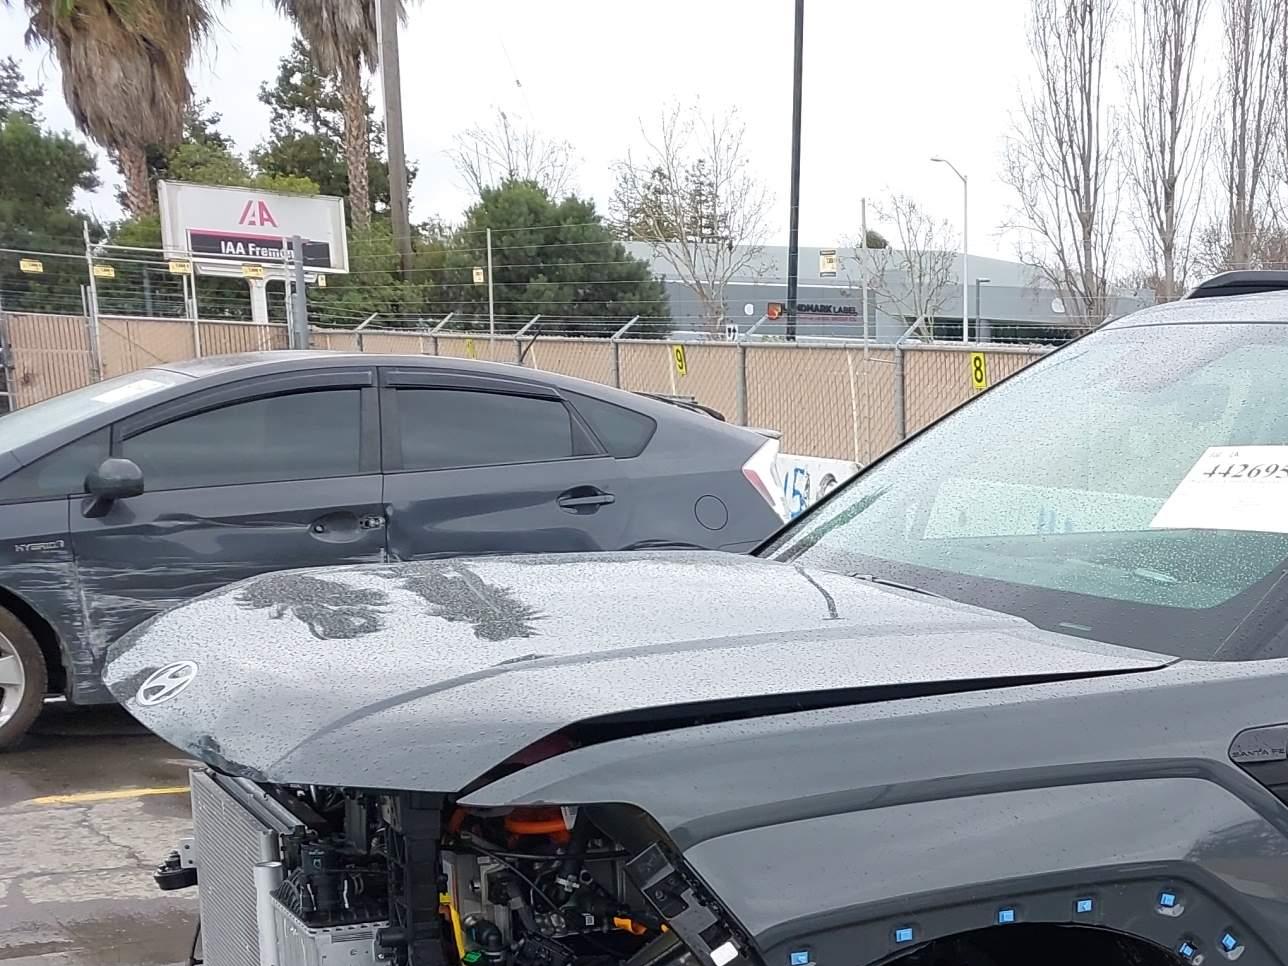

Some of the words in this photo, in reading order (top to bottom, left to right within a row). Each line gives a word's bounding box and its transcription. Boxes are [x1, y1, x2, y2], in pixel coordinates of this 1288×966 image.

[220, 240, 246, 255] IAA
[248, 243, 296, 260] Fremon
[676, 348, 684, 370] 9
[973, 355, 984, 384] 8
